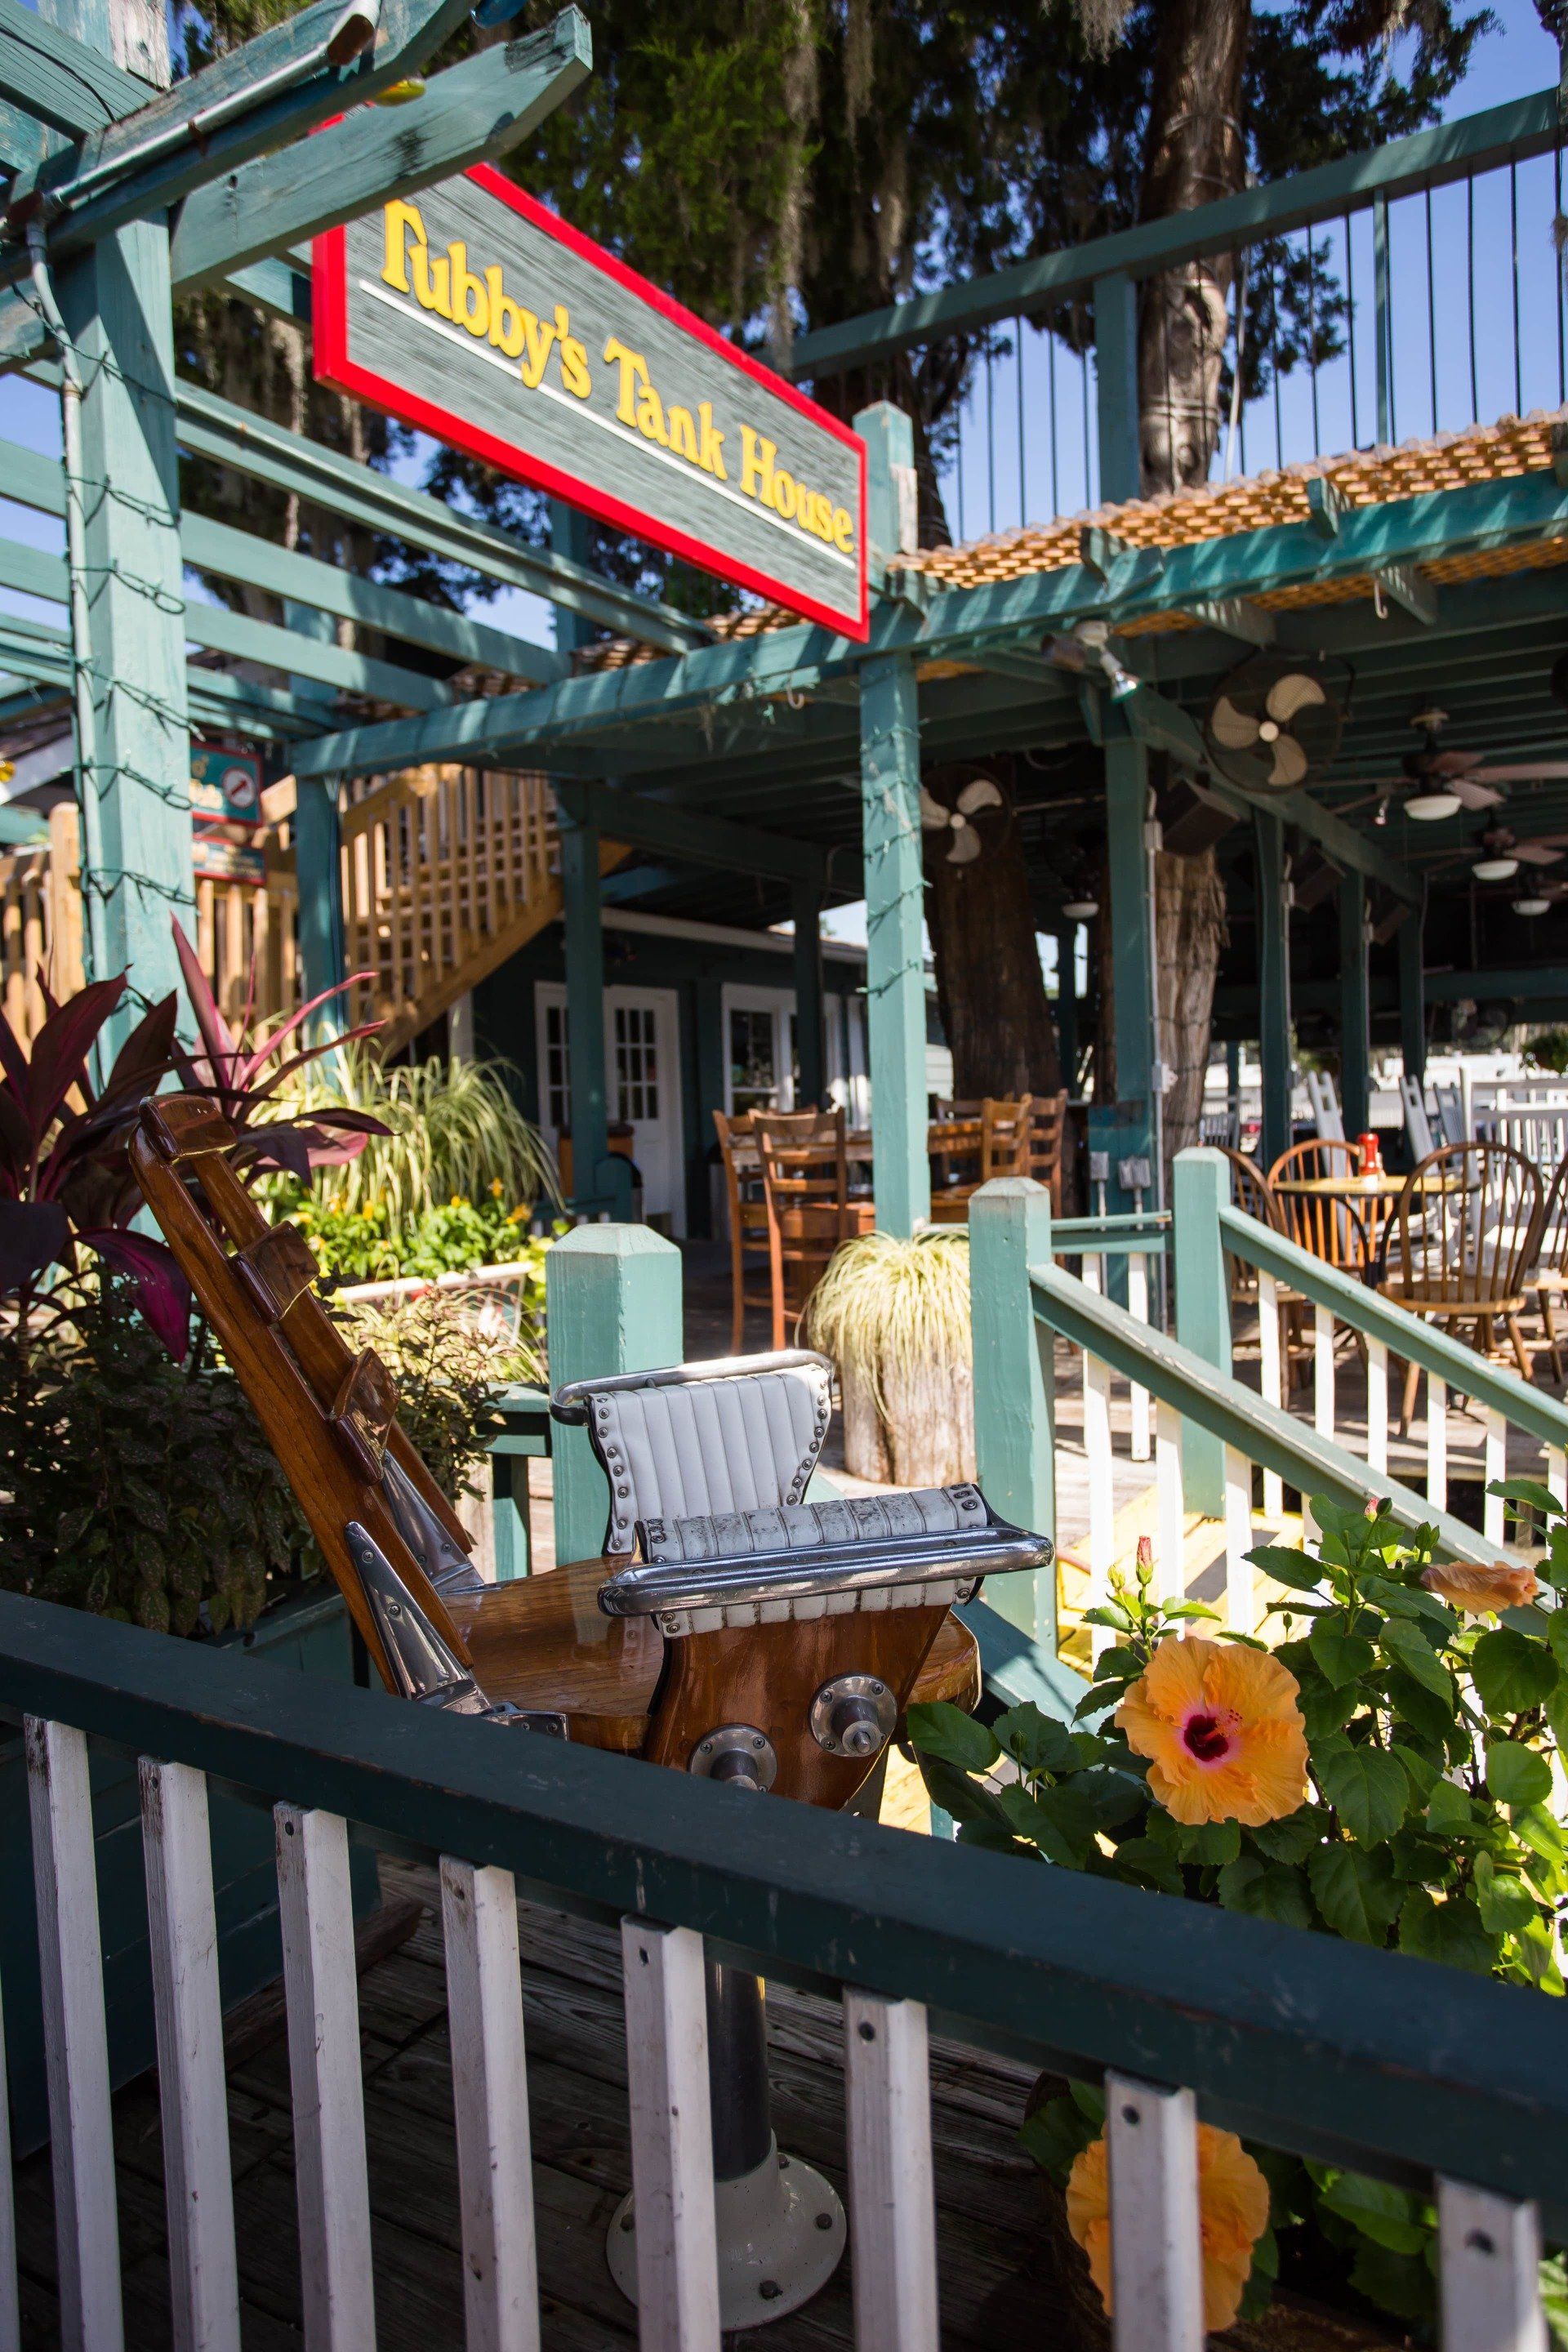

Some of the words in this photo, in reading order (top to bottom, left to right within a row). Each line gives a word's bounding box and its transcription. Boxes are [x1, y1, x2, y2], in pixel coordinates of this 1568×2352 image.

[381, 199, 592, 399] Tubby's
[603, 336, 728, 481] Tank
[740, 424, 855, 555] House
